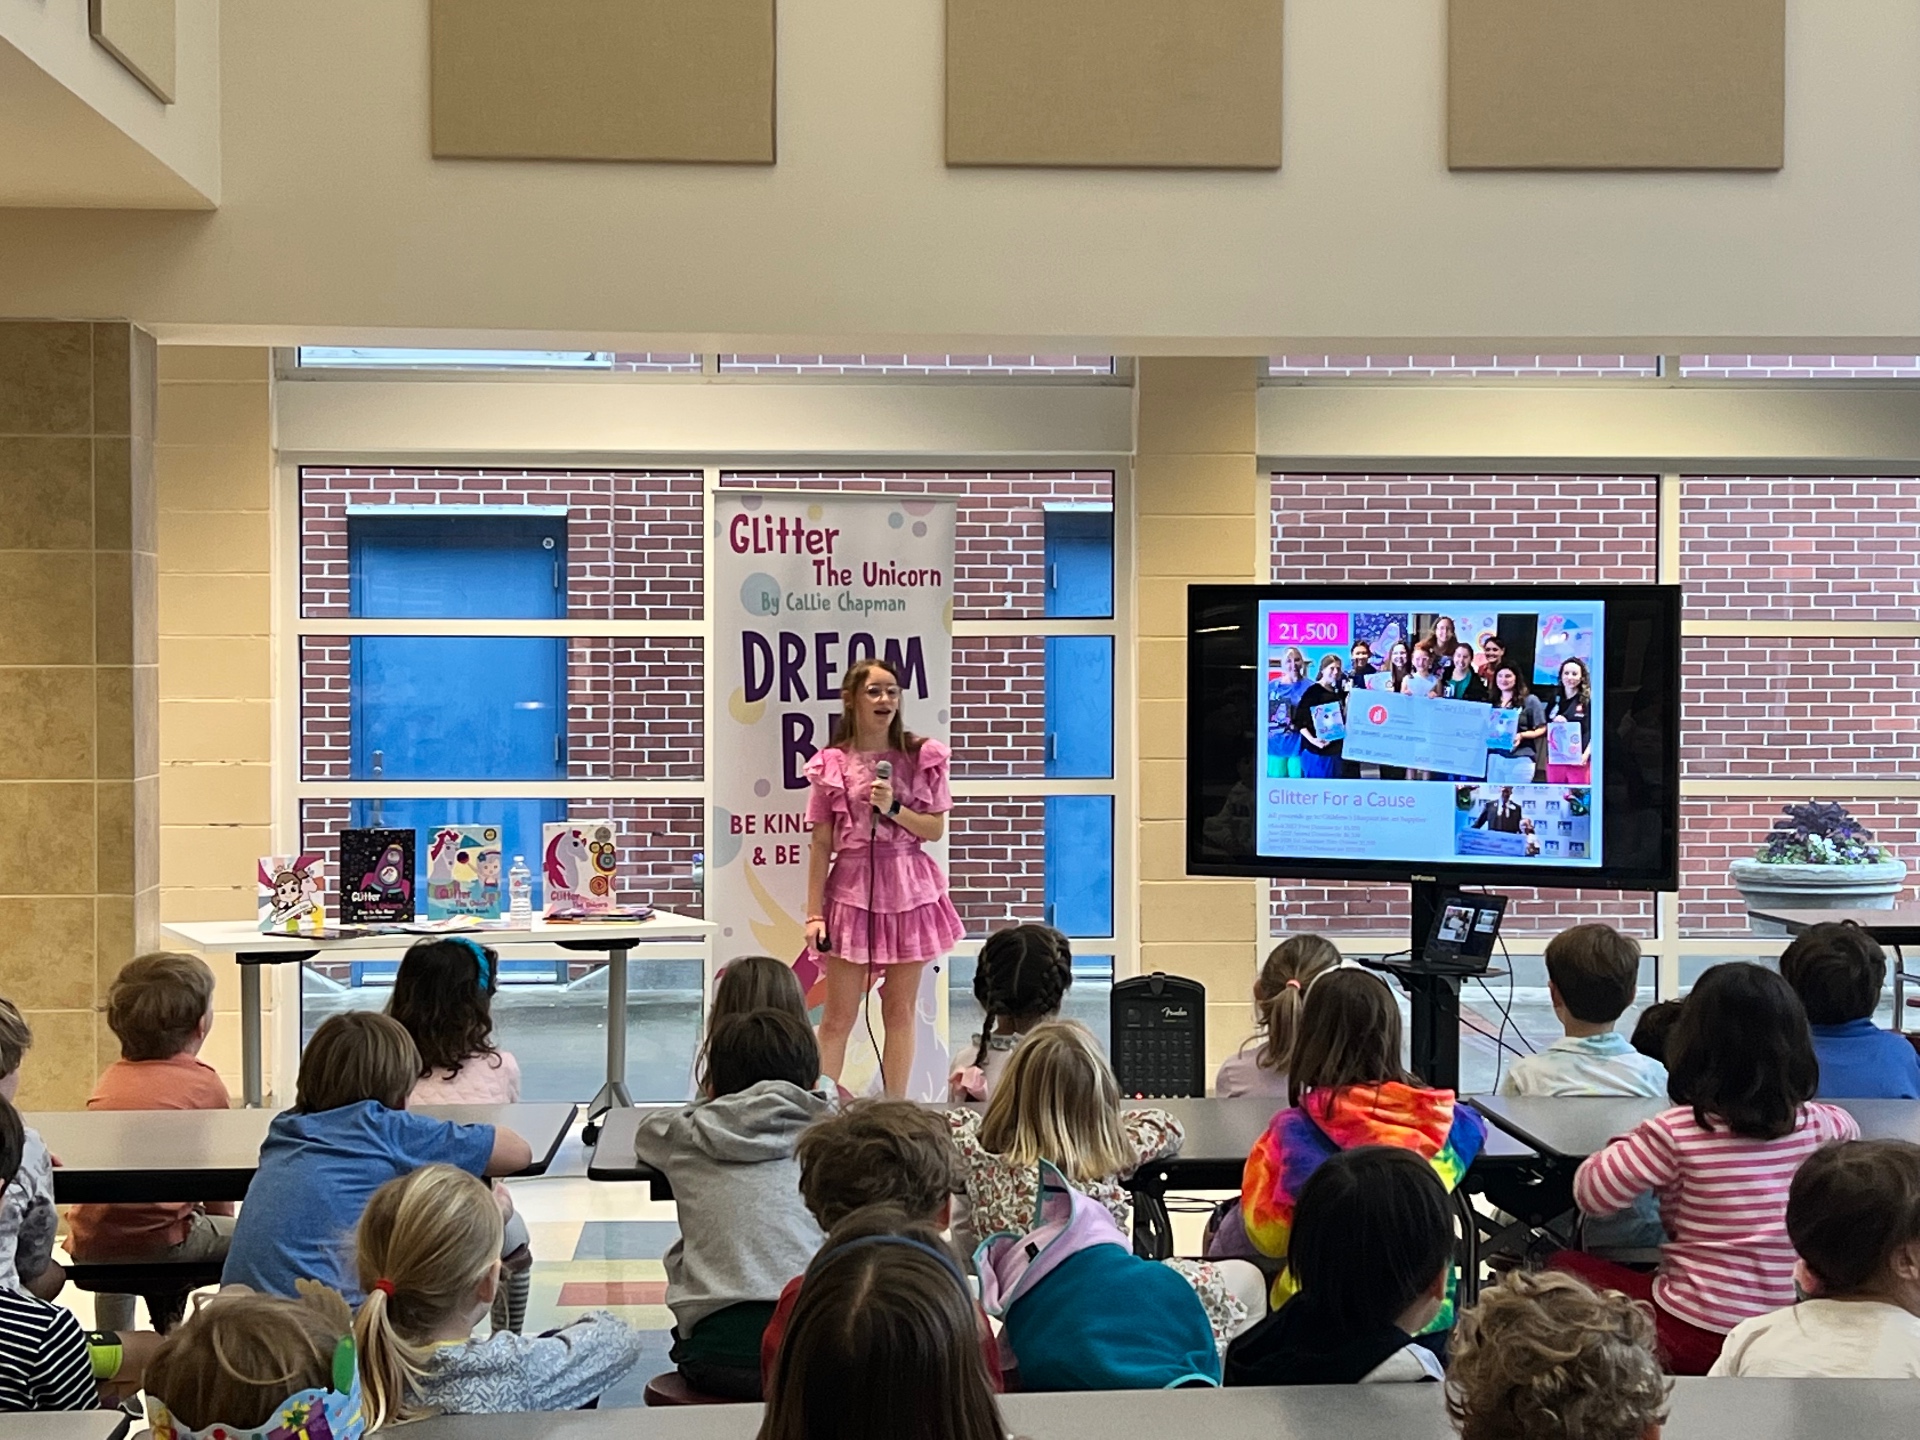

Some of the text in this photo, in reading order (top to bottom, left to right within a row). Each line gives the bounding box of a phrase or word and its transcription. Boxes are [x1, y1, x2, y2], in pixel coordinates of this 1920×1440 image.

[812, 556, 942, 587] The Unicorn
[761, 591, 779, 616] By
[838, 590, 906, 618] Chapman
[1278, 622, 1338, 644] 21,500
[1267, 788, 1416, 809] Glitter For a Cause
[730, 814, 756, 835] BE
[752, 846, 767, 866] &
[775, 844, 800, 865] BE
